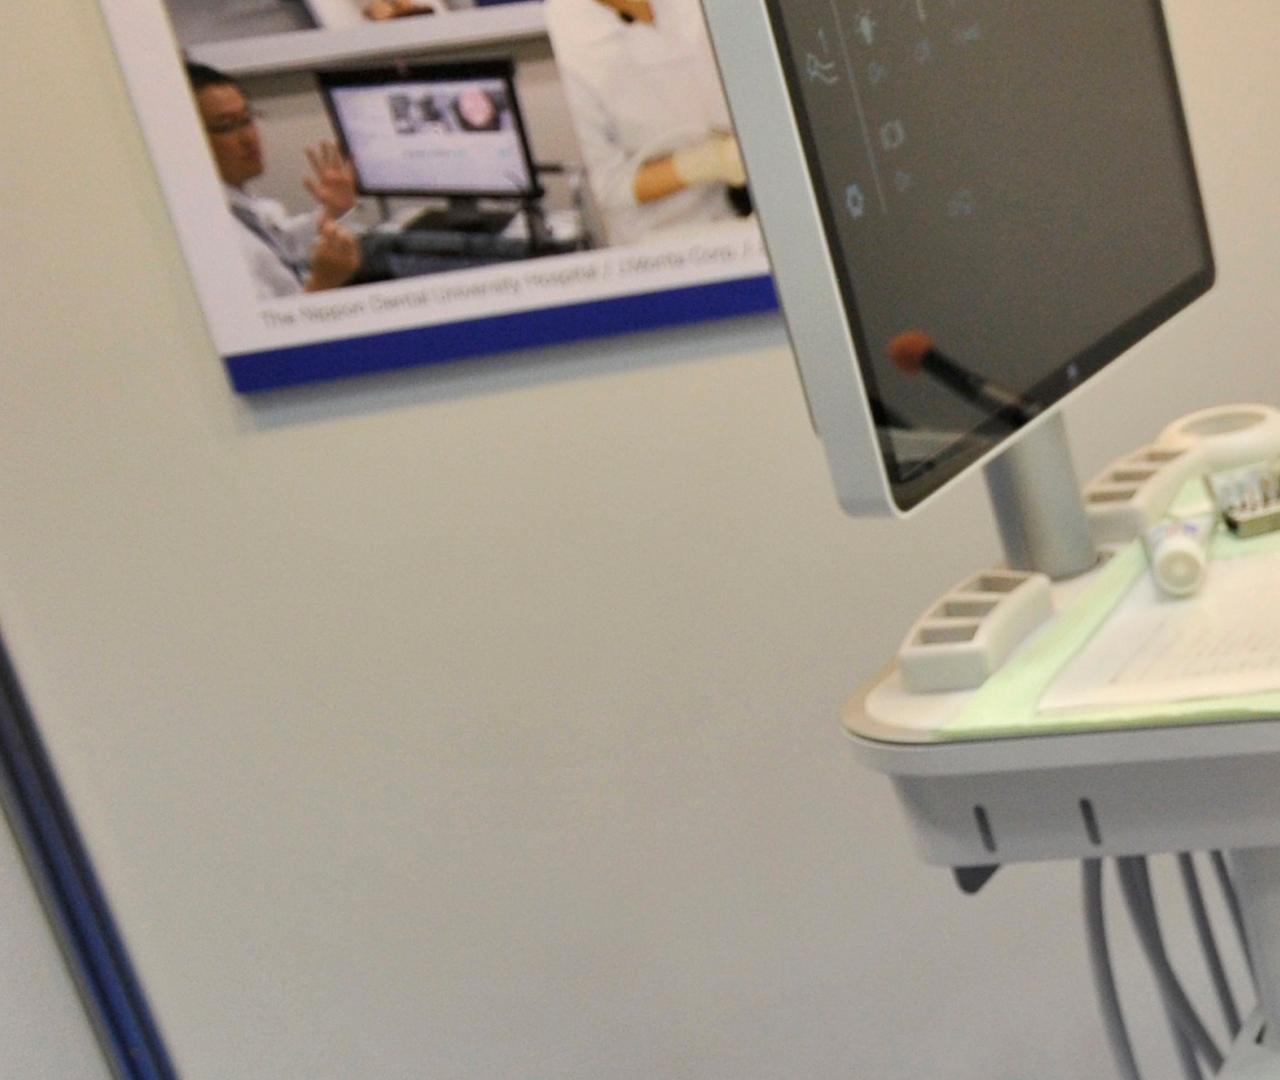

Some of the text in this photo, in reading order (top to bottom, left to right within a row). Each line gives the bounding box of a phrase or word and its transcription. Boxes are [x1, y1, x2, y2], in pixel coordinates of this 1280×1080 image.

[260, 309, 295, 326] The
[300, 301, 366, 323] Nippon
[371, 291, 428, 310] Dental
[434, 277, 520, 300] University
[526, 262, 597, 286] Hospital
